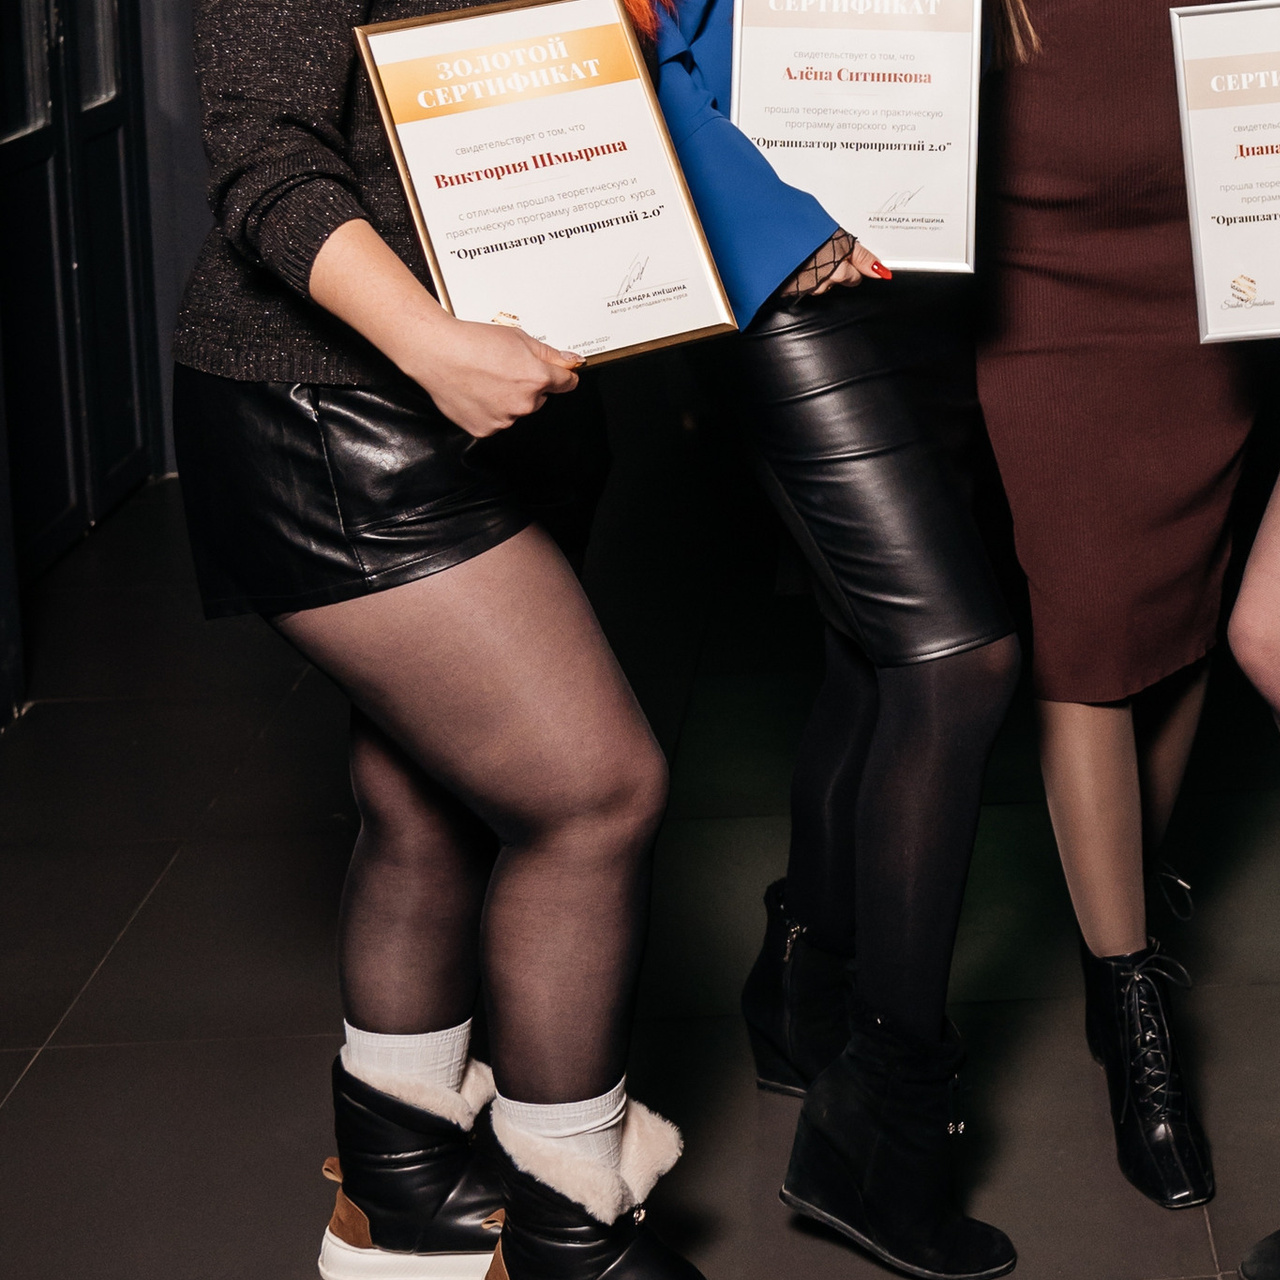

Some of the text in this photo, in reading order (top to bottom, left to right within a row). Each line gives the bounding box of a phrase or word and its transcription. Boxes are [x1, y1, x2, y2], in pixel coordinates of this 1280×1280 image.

[439, 37, 568, 79] ЗОЛОТОЙ
[793, 51, 868, 62] свидетельствует
[879, 53, 897, 61] том,
[418, 59, 598, 108] СЕРТИФИКАТ
[782, 66, 931, 83] Алёна Ситникова
[764, 106, 800, 115] прошла
[802, 107, 870, 118] теоретическую
[880, 110, 944, 120] практическую
[455, 133, 535, 156] свидетельствует
[546, 128, 567, 136] том,
[568, 124, 586, 132] что
[785, 121, 916, 133] программу авторского курса
[750, 136, 952, 152] "Организатор мероприятий 2.0"
[434, 141, 628, 189] Виктория Шмырина
[458, 213, 464, 221] с
[466, 203, 514, 220] отличием
[516, 194, 556, 210] прошла
[556, 179, 629, 200] теоретическую
[1219, 183, 1254, 193] прошла
[446, 188, 656, 240] практическую программу авторского курса
[450, 205, 664, 260] "Организатор мероприятий 2.0"
[607, 284, 687, 307] АЛЕКСАНДРА ИНЁШИНА
